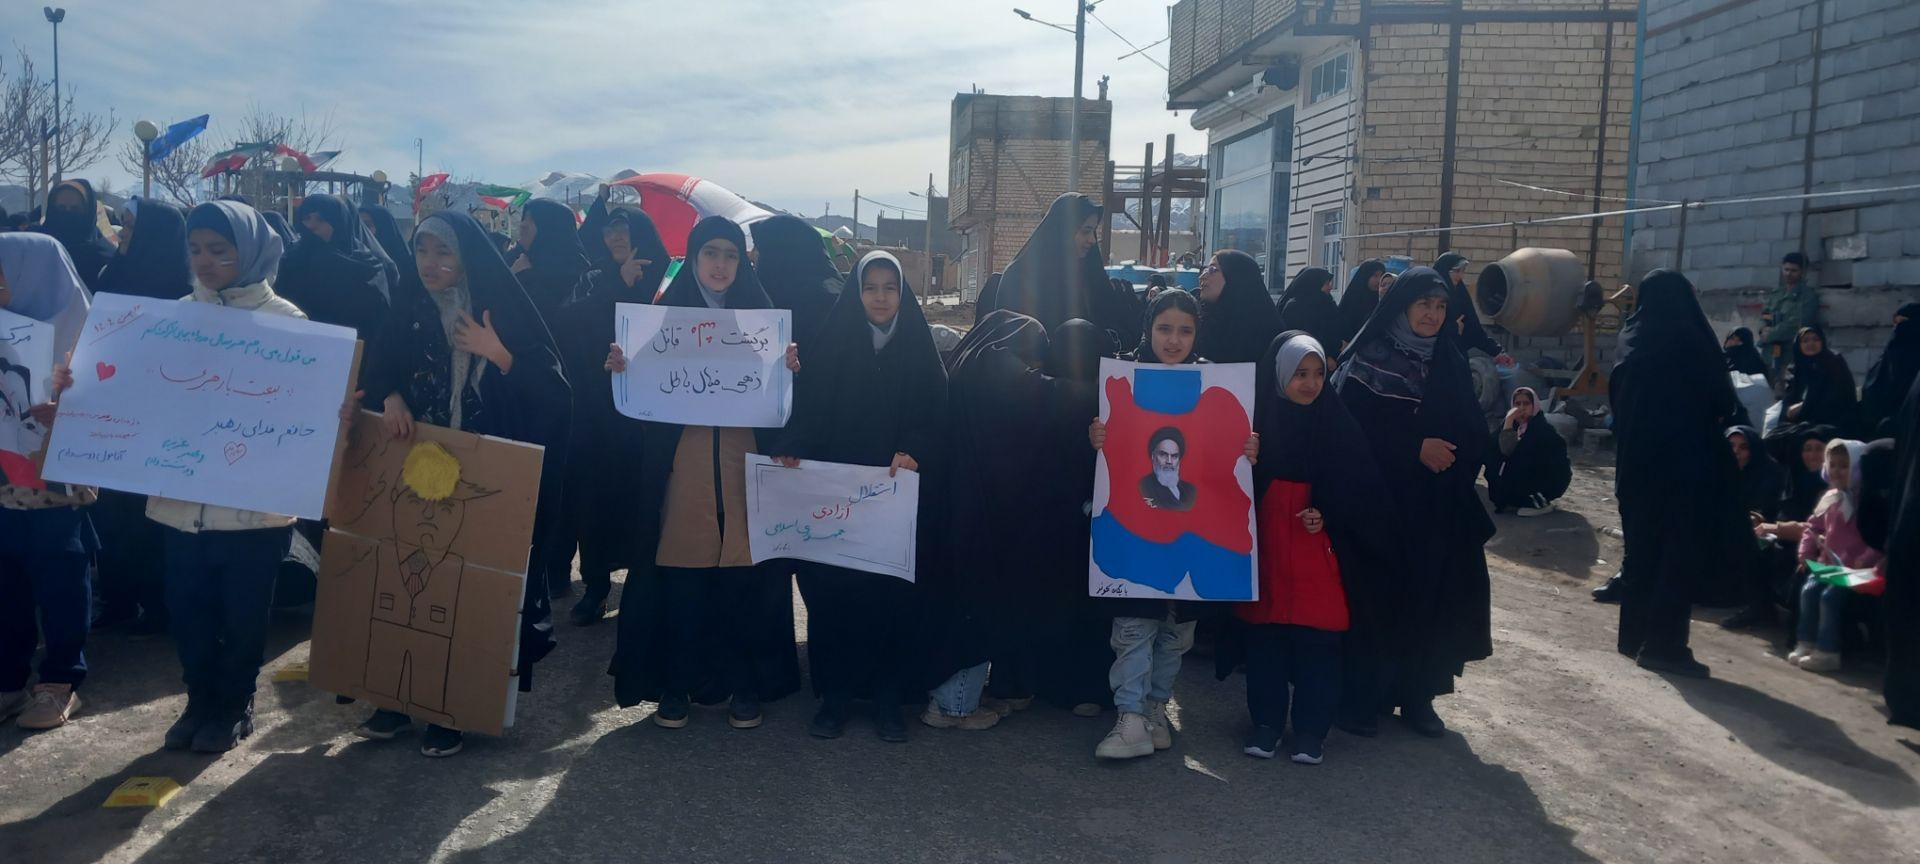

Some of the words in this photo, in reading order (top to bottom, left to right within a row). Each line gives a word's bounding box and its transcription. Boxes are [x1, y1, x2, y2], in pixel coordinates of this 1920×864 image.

[278, 346, 300, 364] قول
[232, 380, 280, 403] بیعت
[848, 481, 897, 504] استقلال
[812, 503, 851, 520] آزادی
